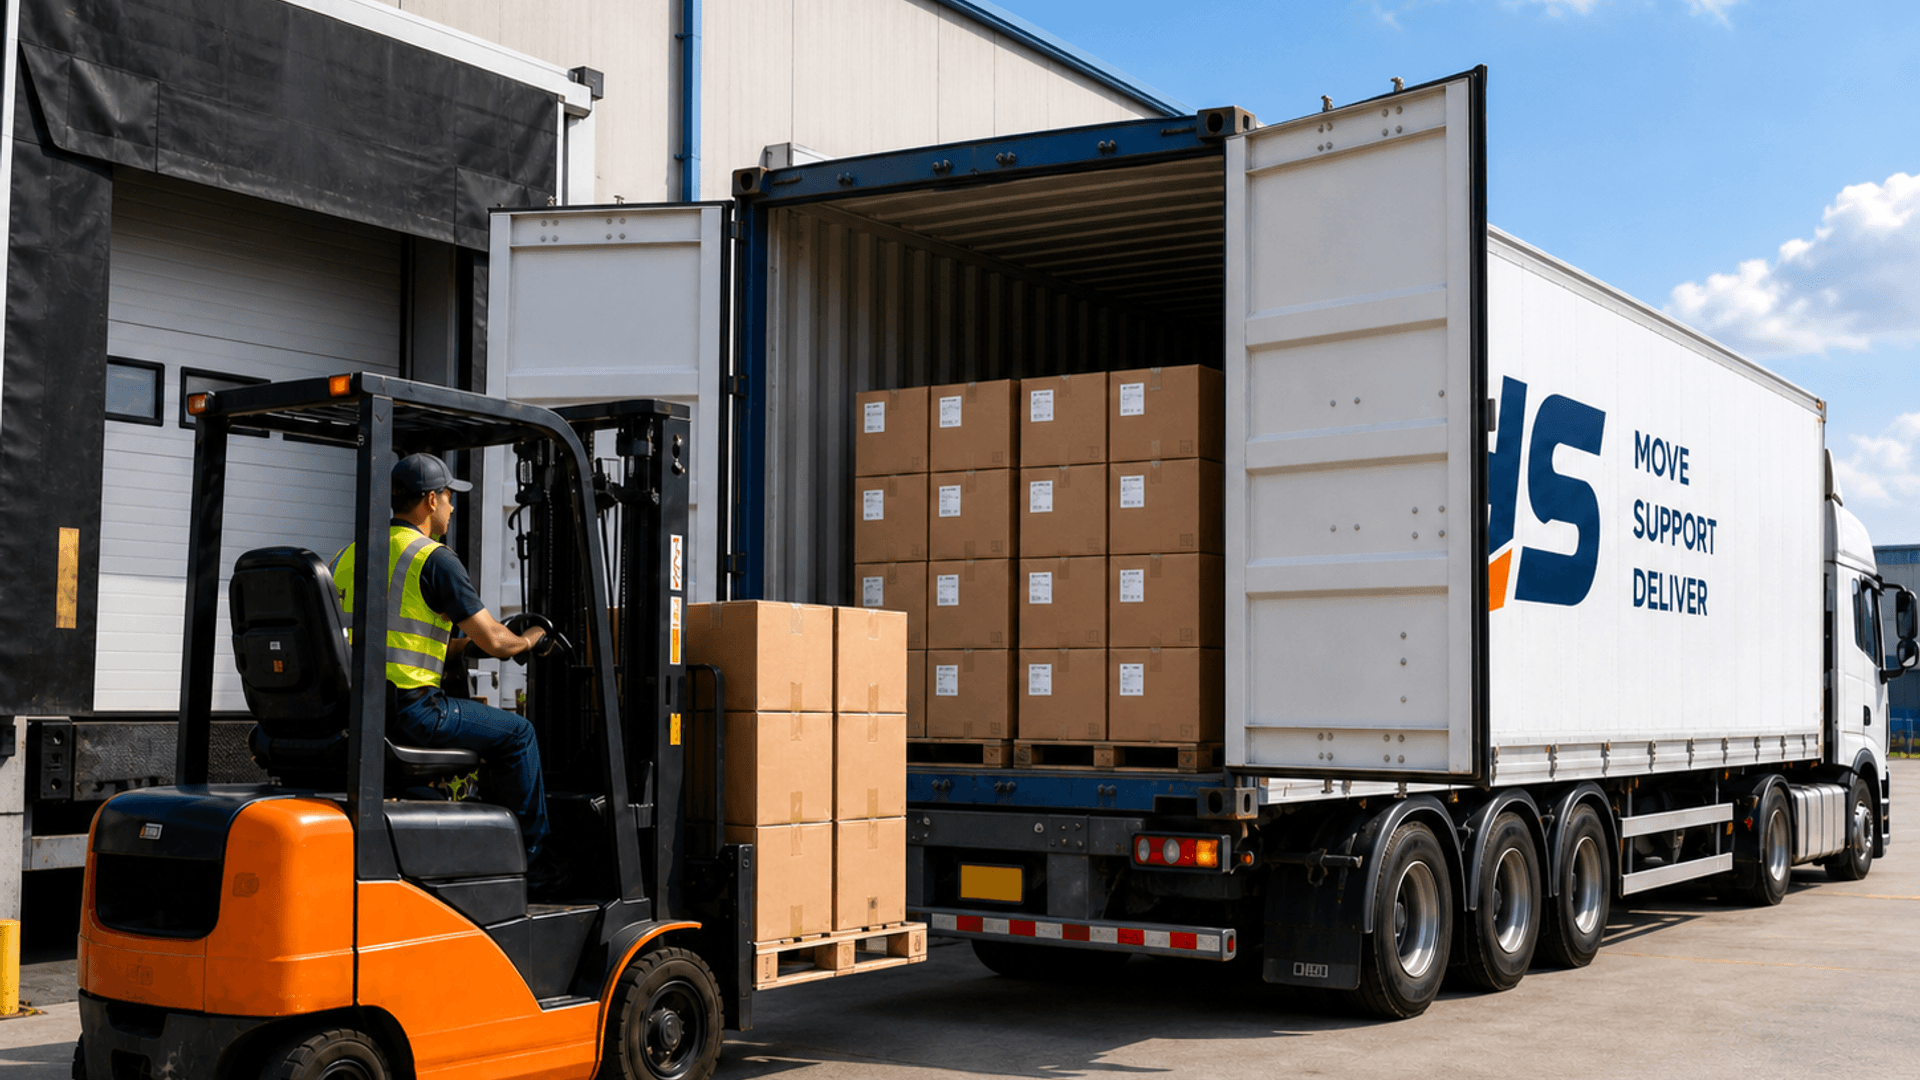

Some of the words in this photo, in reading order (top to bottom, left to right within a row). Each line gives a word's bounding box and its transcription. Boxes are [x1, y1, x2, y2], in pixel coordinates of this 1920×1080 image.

[1634, 430, 1690, 486] MOVE
[1633, 499, 1717, 555] SUPPORT
[1633, 567, 1708, 616] DELIVER
